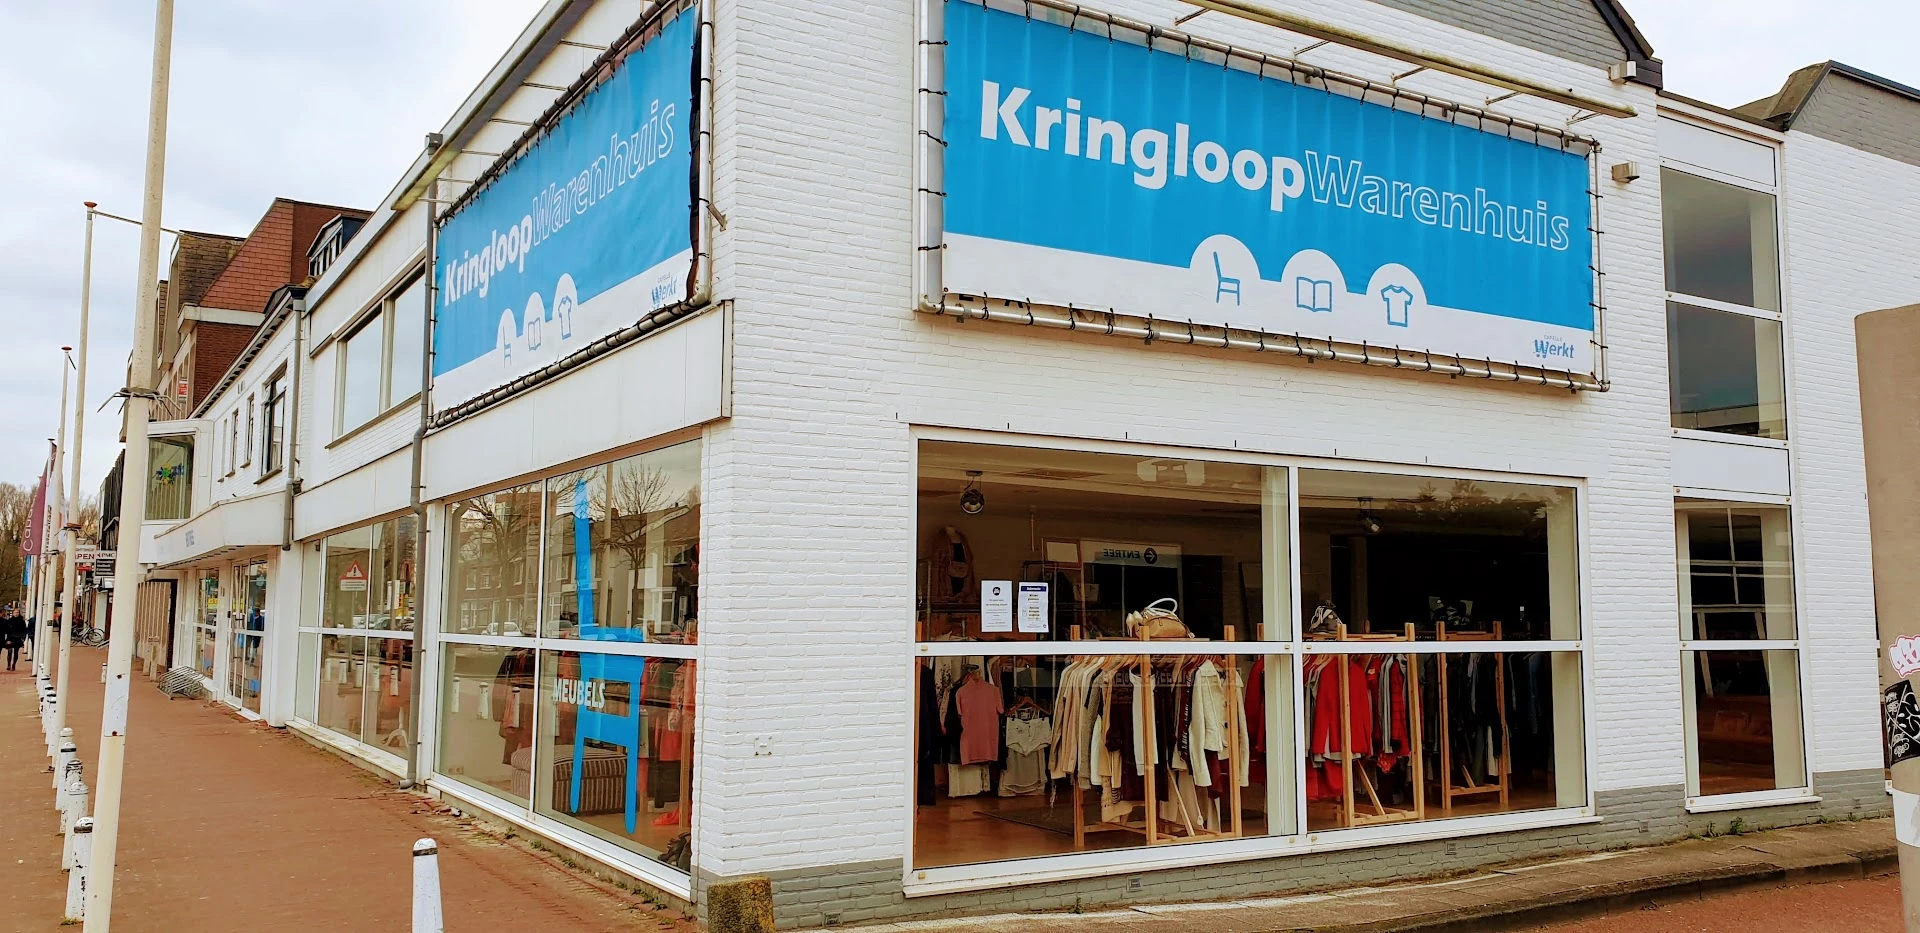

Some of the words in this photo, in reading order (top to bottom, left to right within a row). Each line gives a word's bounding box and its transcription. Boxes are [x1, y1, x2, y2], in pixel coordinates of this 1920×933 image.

[980, 79, 1569, 251] KringloopWarenhuis
[444, 98, 675, 306] KringloopWarenhuis
[651, 276, 678, 307] Werkt
[1534, 339, 1575, 359] Werkt
[553, 677, 606, 709] MEUBELS
